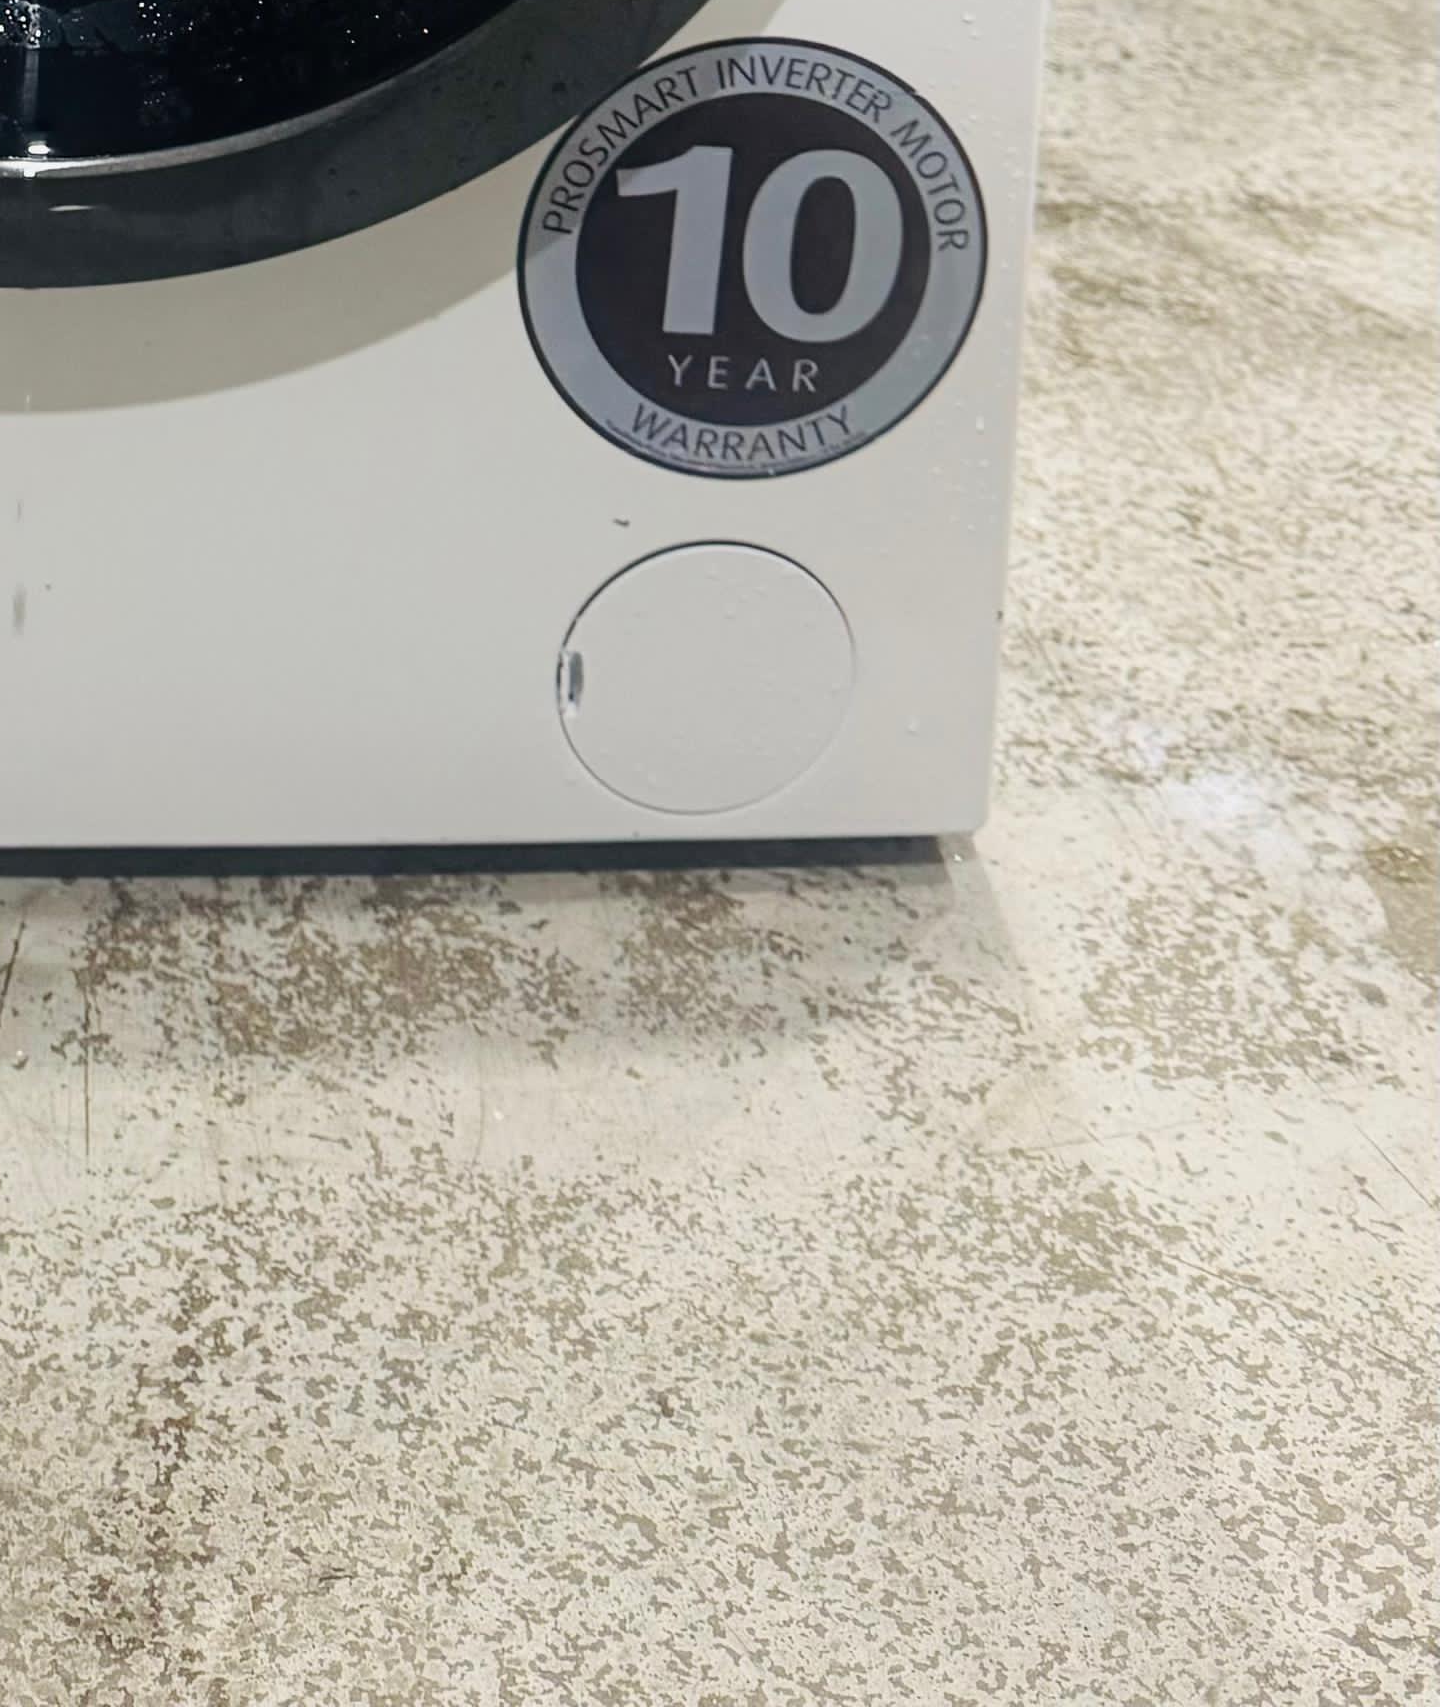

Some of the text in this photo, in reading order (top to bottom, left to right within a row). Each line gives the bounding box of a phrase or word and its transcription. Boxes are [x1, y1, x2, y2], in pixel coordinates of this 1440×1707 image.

[543, 55, 970, 252] PROSMART INVERTER MOTOR
[616, 145, 904, 343] 10
[631, 403, 852, 462] WARRANTY
[668, 354, 820, 392] YEAR
